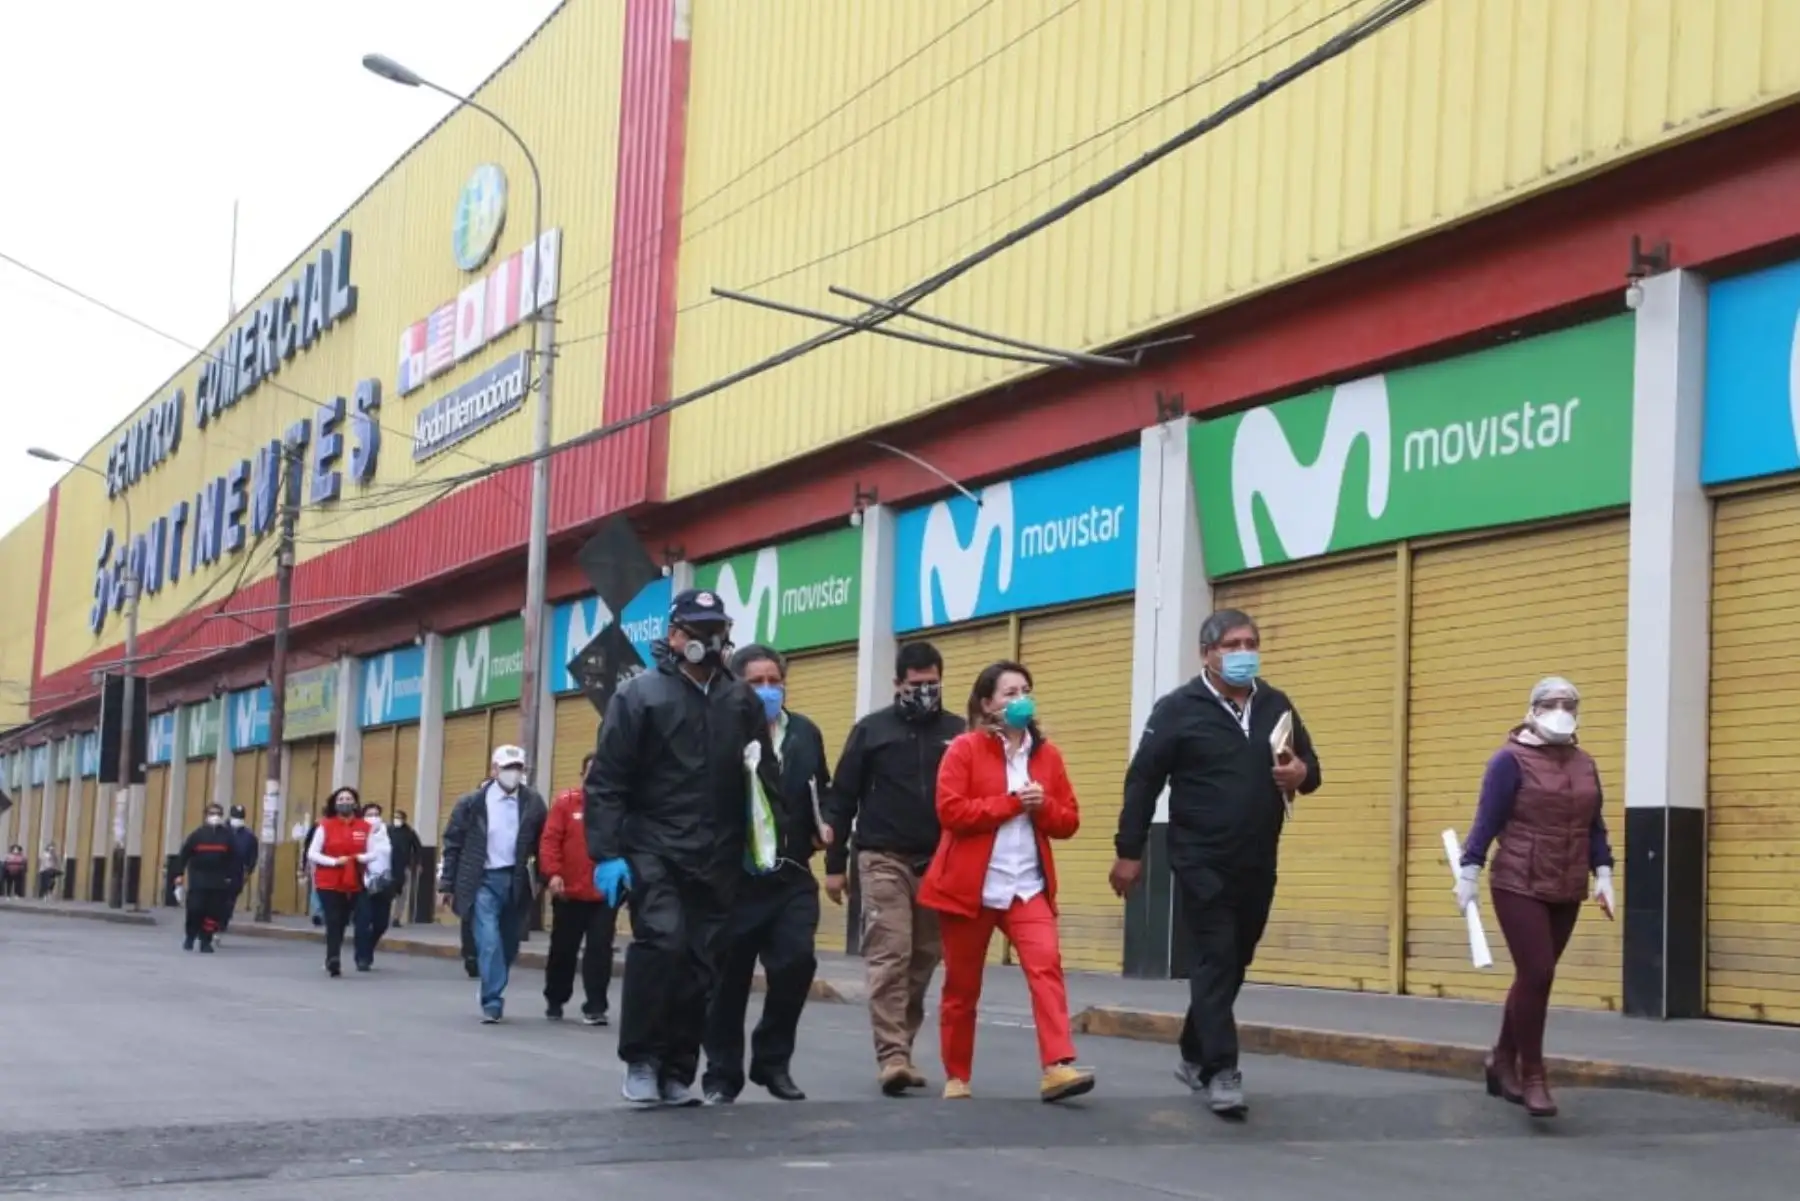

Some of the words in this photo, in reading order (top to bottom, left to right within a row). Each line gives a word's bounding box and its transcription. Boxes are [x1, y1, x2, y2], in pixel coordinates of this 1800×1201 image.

[105, 387, 186, 499] CENTRO
[195, 230, 358, 429] COMERCIAL
[1403, 398, 1580, 472] movistar
[1020, 504, 1124, 559] movistar
[782, 575, 853, 616] movistar
